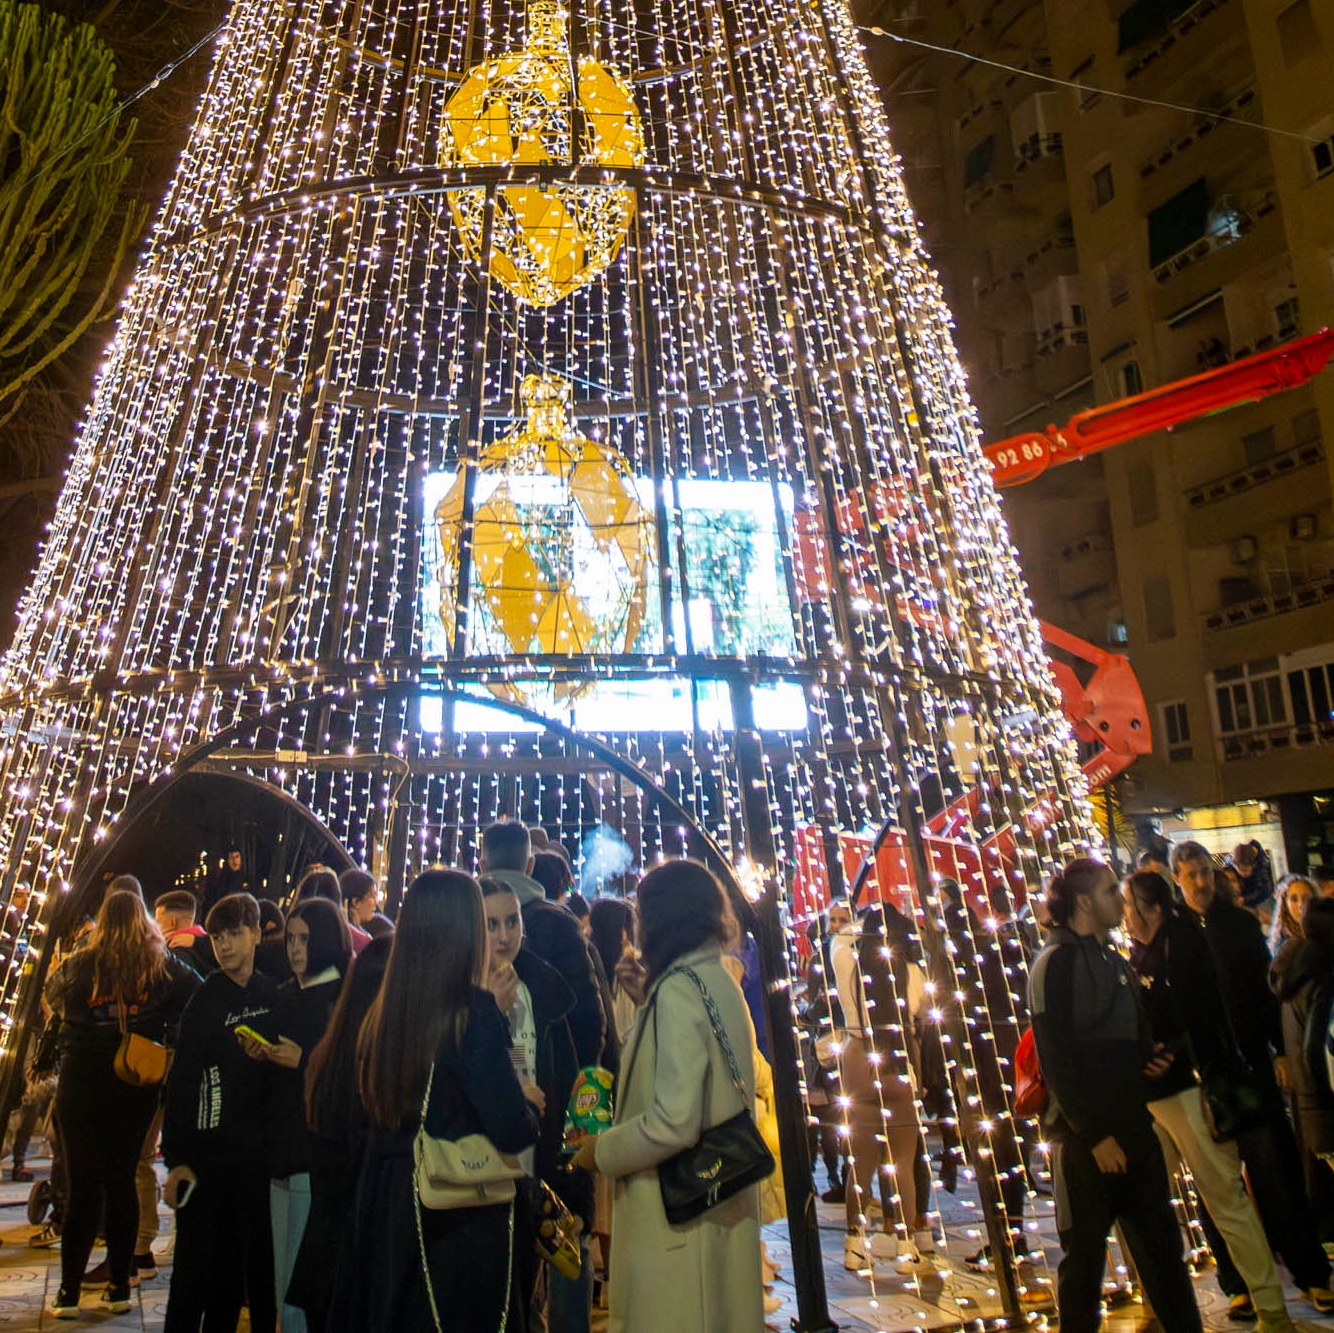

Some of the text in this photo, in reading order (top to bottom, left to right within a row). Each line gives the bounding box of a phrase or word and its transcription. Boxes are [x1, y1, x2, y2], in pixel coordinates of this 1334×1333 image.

[1020, 440, 1044, 461] 86
[209, 1065, 222, 1129] LOS ANGELES
